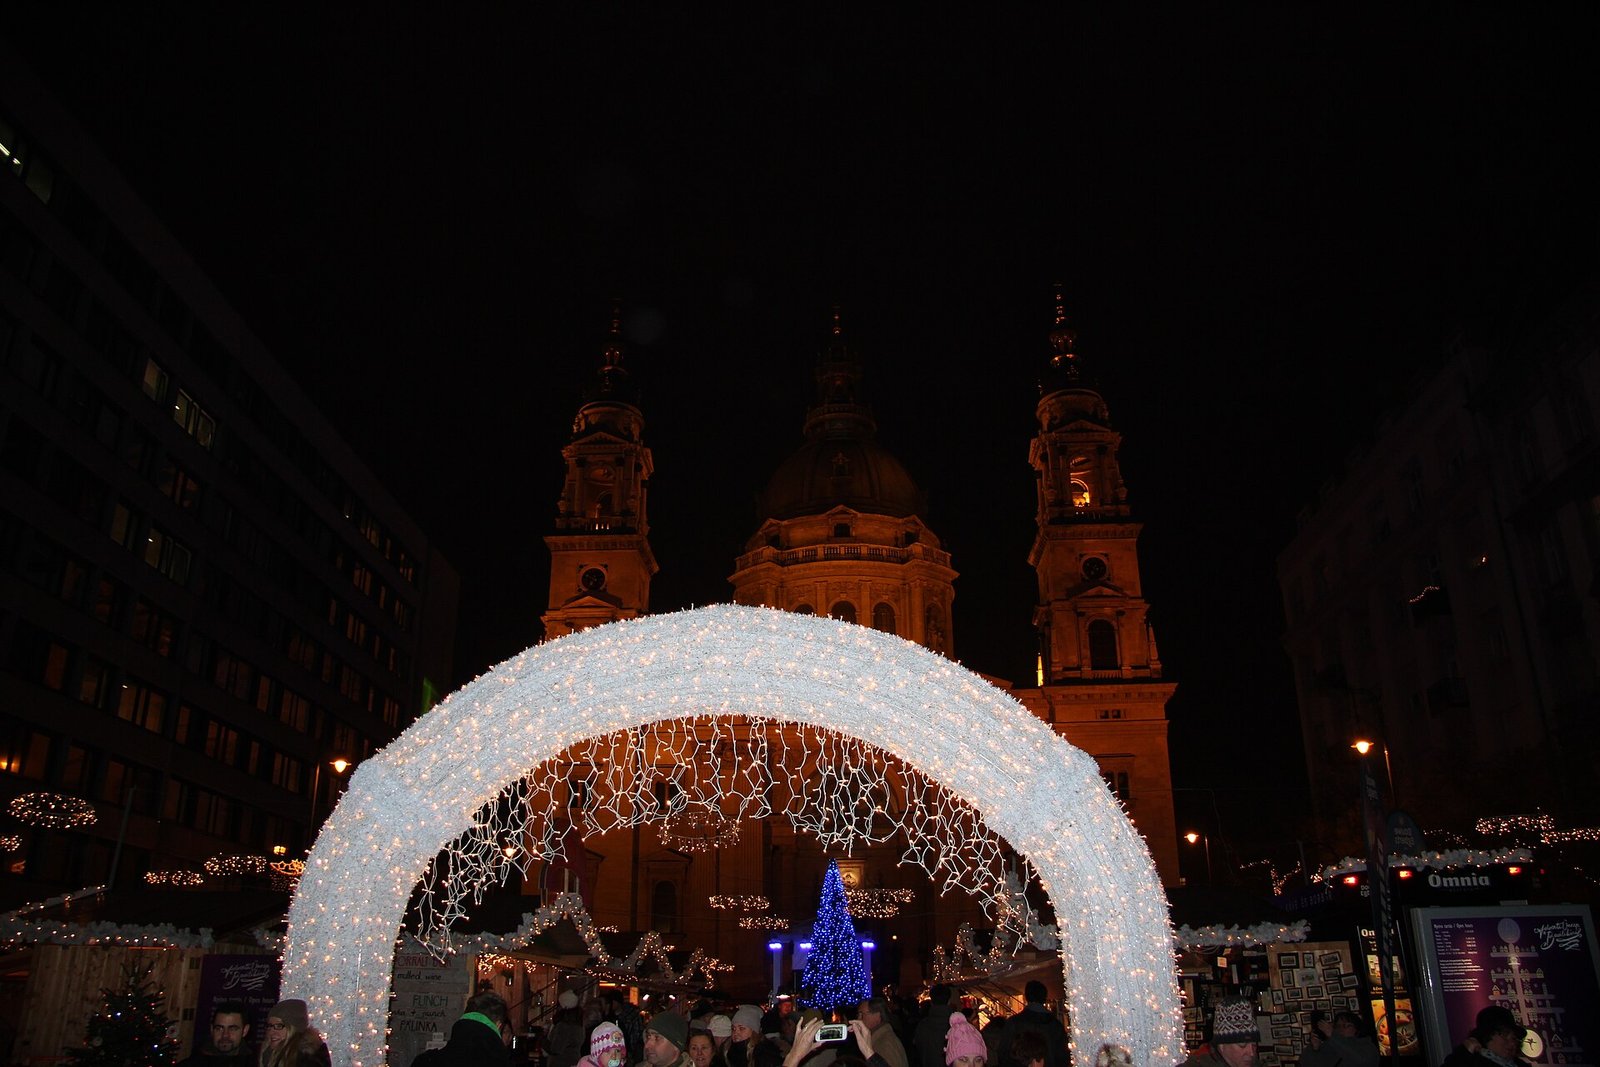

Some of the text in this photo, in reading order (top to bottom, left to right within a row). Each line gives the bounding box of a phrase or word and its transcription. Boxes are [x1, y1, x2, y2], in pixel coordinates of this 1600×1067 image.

[1428, 872, 1490, 888] Omnia
[397, 955, 428, 967] ORRALT
[396, 970, 422, 980] mulled
[412, 994, 449, 1007] PUNCH
[422, 1009, 447, 1018] punch
